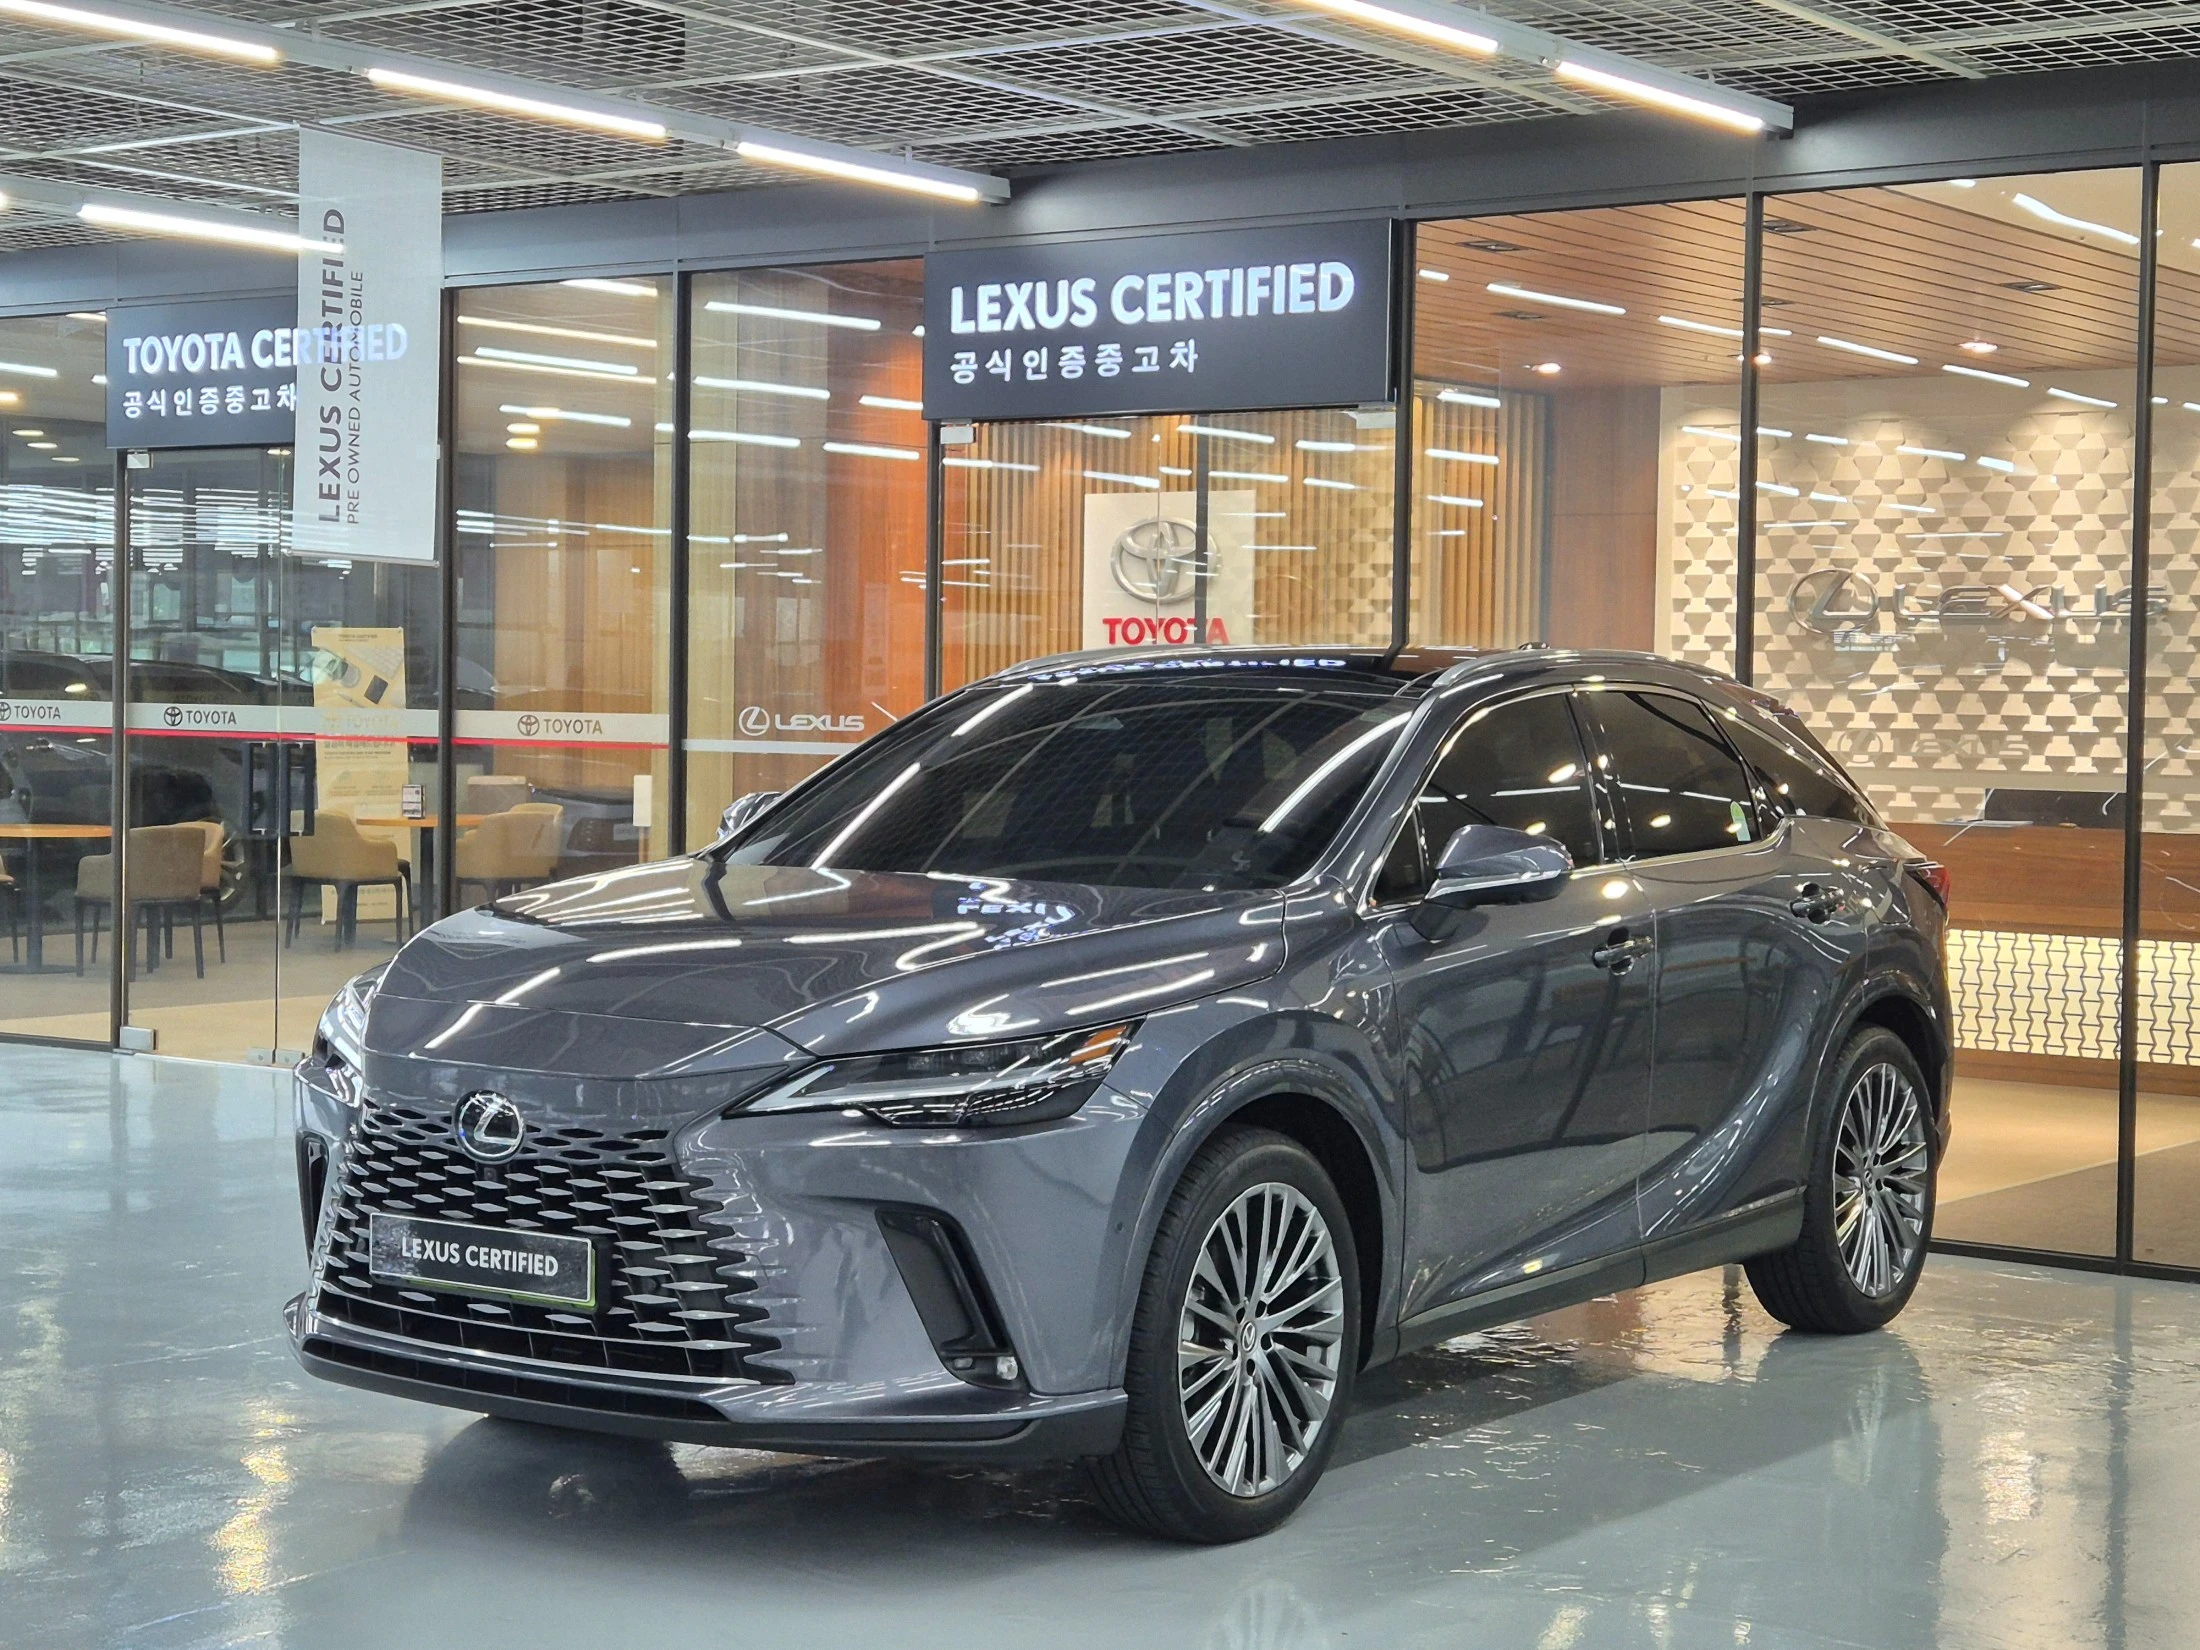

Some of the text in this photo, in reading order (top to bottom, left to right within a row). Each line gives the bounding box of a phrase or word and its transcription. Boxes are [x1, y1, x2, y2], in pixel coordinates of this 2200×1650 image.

[950, 261, 1355, 334] LEXUS CERTIFIED
[122, 331, 246, 374] TOYOTA
[950, 337, 1199, 385] 공식인증중고차
[122, 383, 298, 419] 공식인증중고차
[347, 406, 361, 484] OWNED
[318, 405, 342, 523] LEXUS
[346, 489, 360, 524] PRE
[1892, 583, 2169, 621] LEXUS
[1102, 616, 1230, 646] TOYOA
[14, 705, 62, 720] TOYOTA
[186, 709, 237, 725] TOYOTA
[543, 717, 603, 736] TOYOTA
[774, 713, 865, 732] LEXUS
[401, 1236, 559, 1277] LEXUS CERTIFIED
